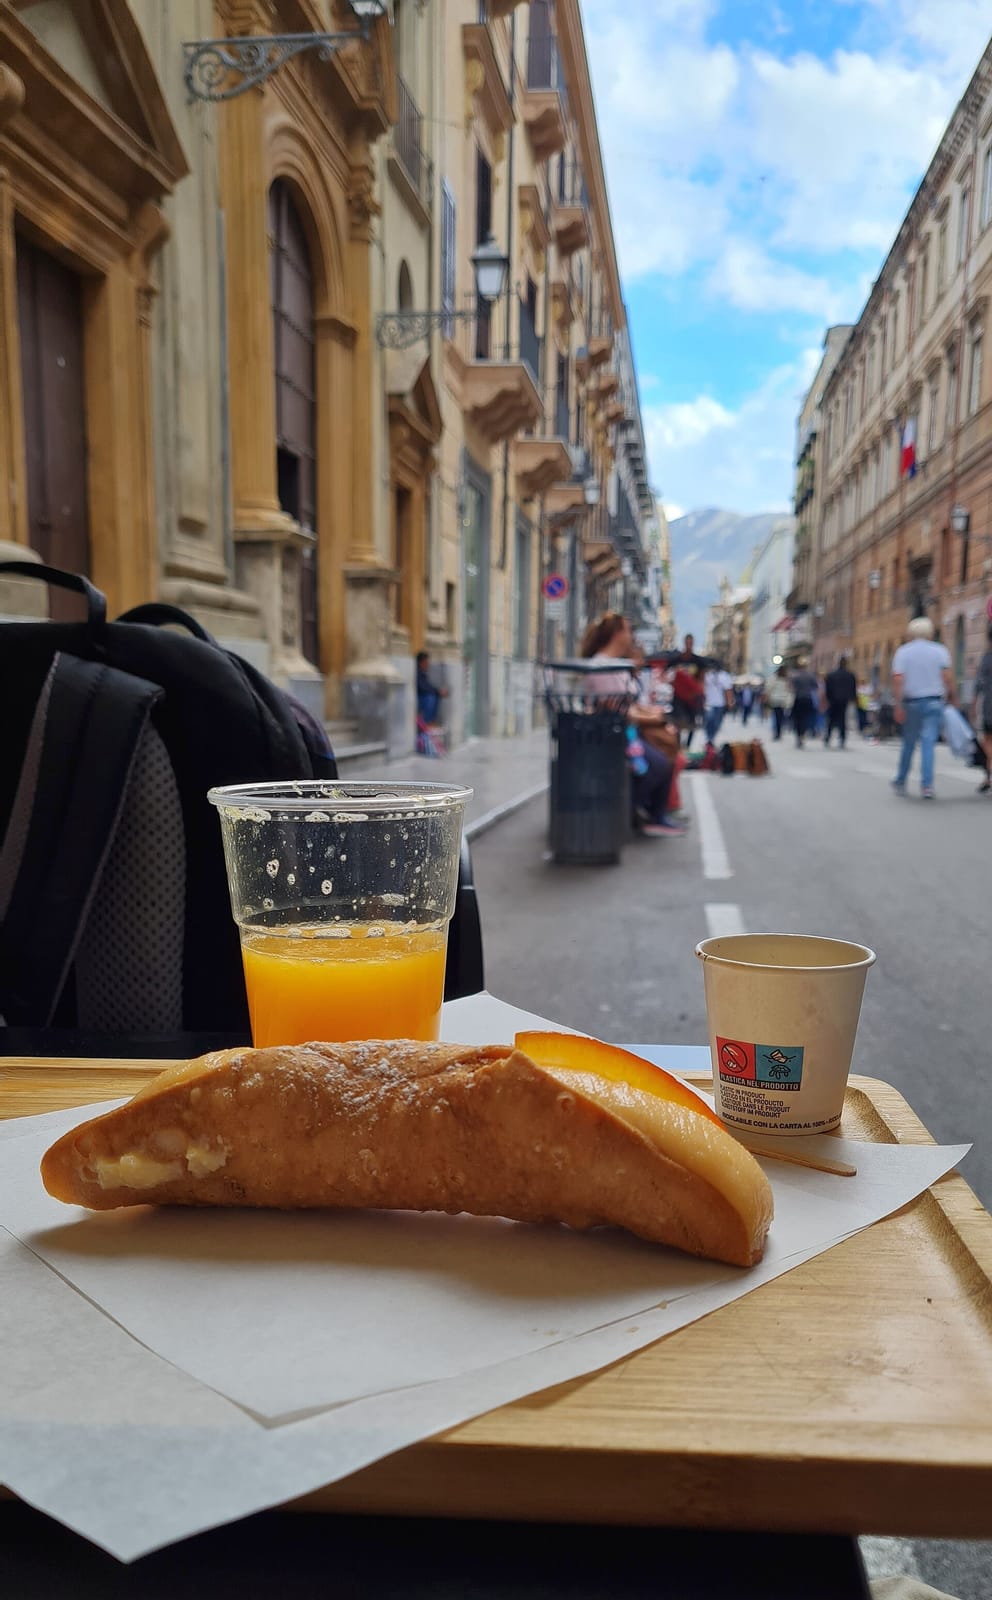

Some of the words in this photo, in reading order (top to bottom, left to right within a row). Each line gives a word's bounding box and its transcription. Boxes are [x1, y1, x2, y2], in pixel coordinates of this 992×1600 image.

[720, 1073, 746, 1085] PLASTICA
[746, 1079, 759, 1088] NEL
[760, 1081, 799, 1090] PRODOTTO
[741, 1089, 766, 1099] PRODUCT
[753, 1098, 784, 1107] PRODUCTO
[757, 1103, 764, 1111] LE
[765, 1104, 790, 1113] PRODUIT
[755, 1110, 781, 1118] PRODUKT
[753, 1120, 768, 1128] CON
